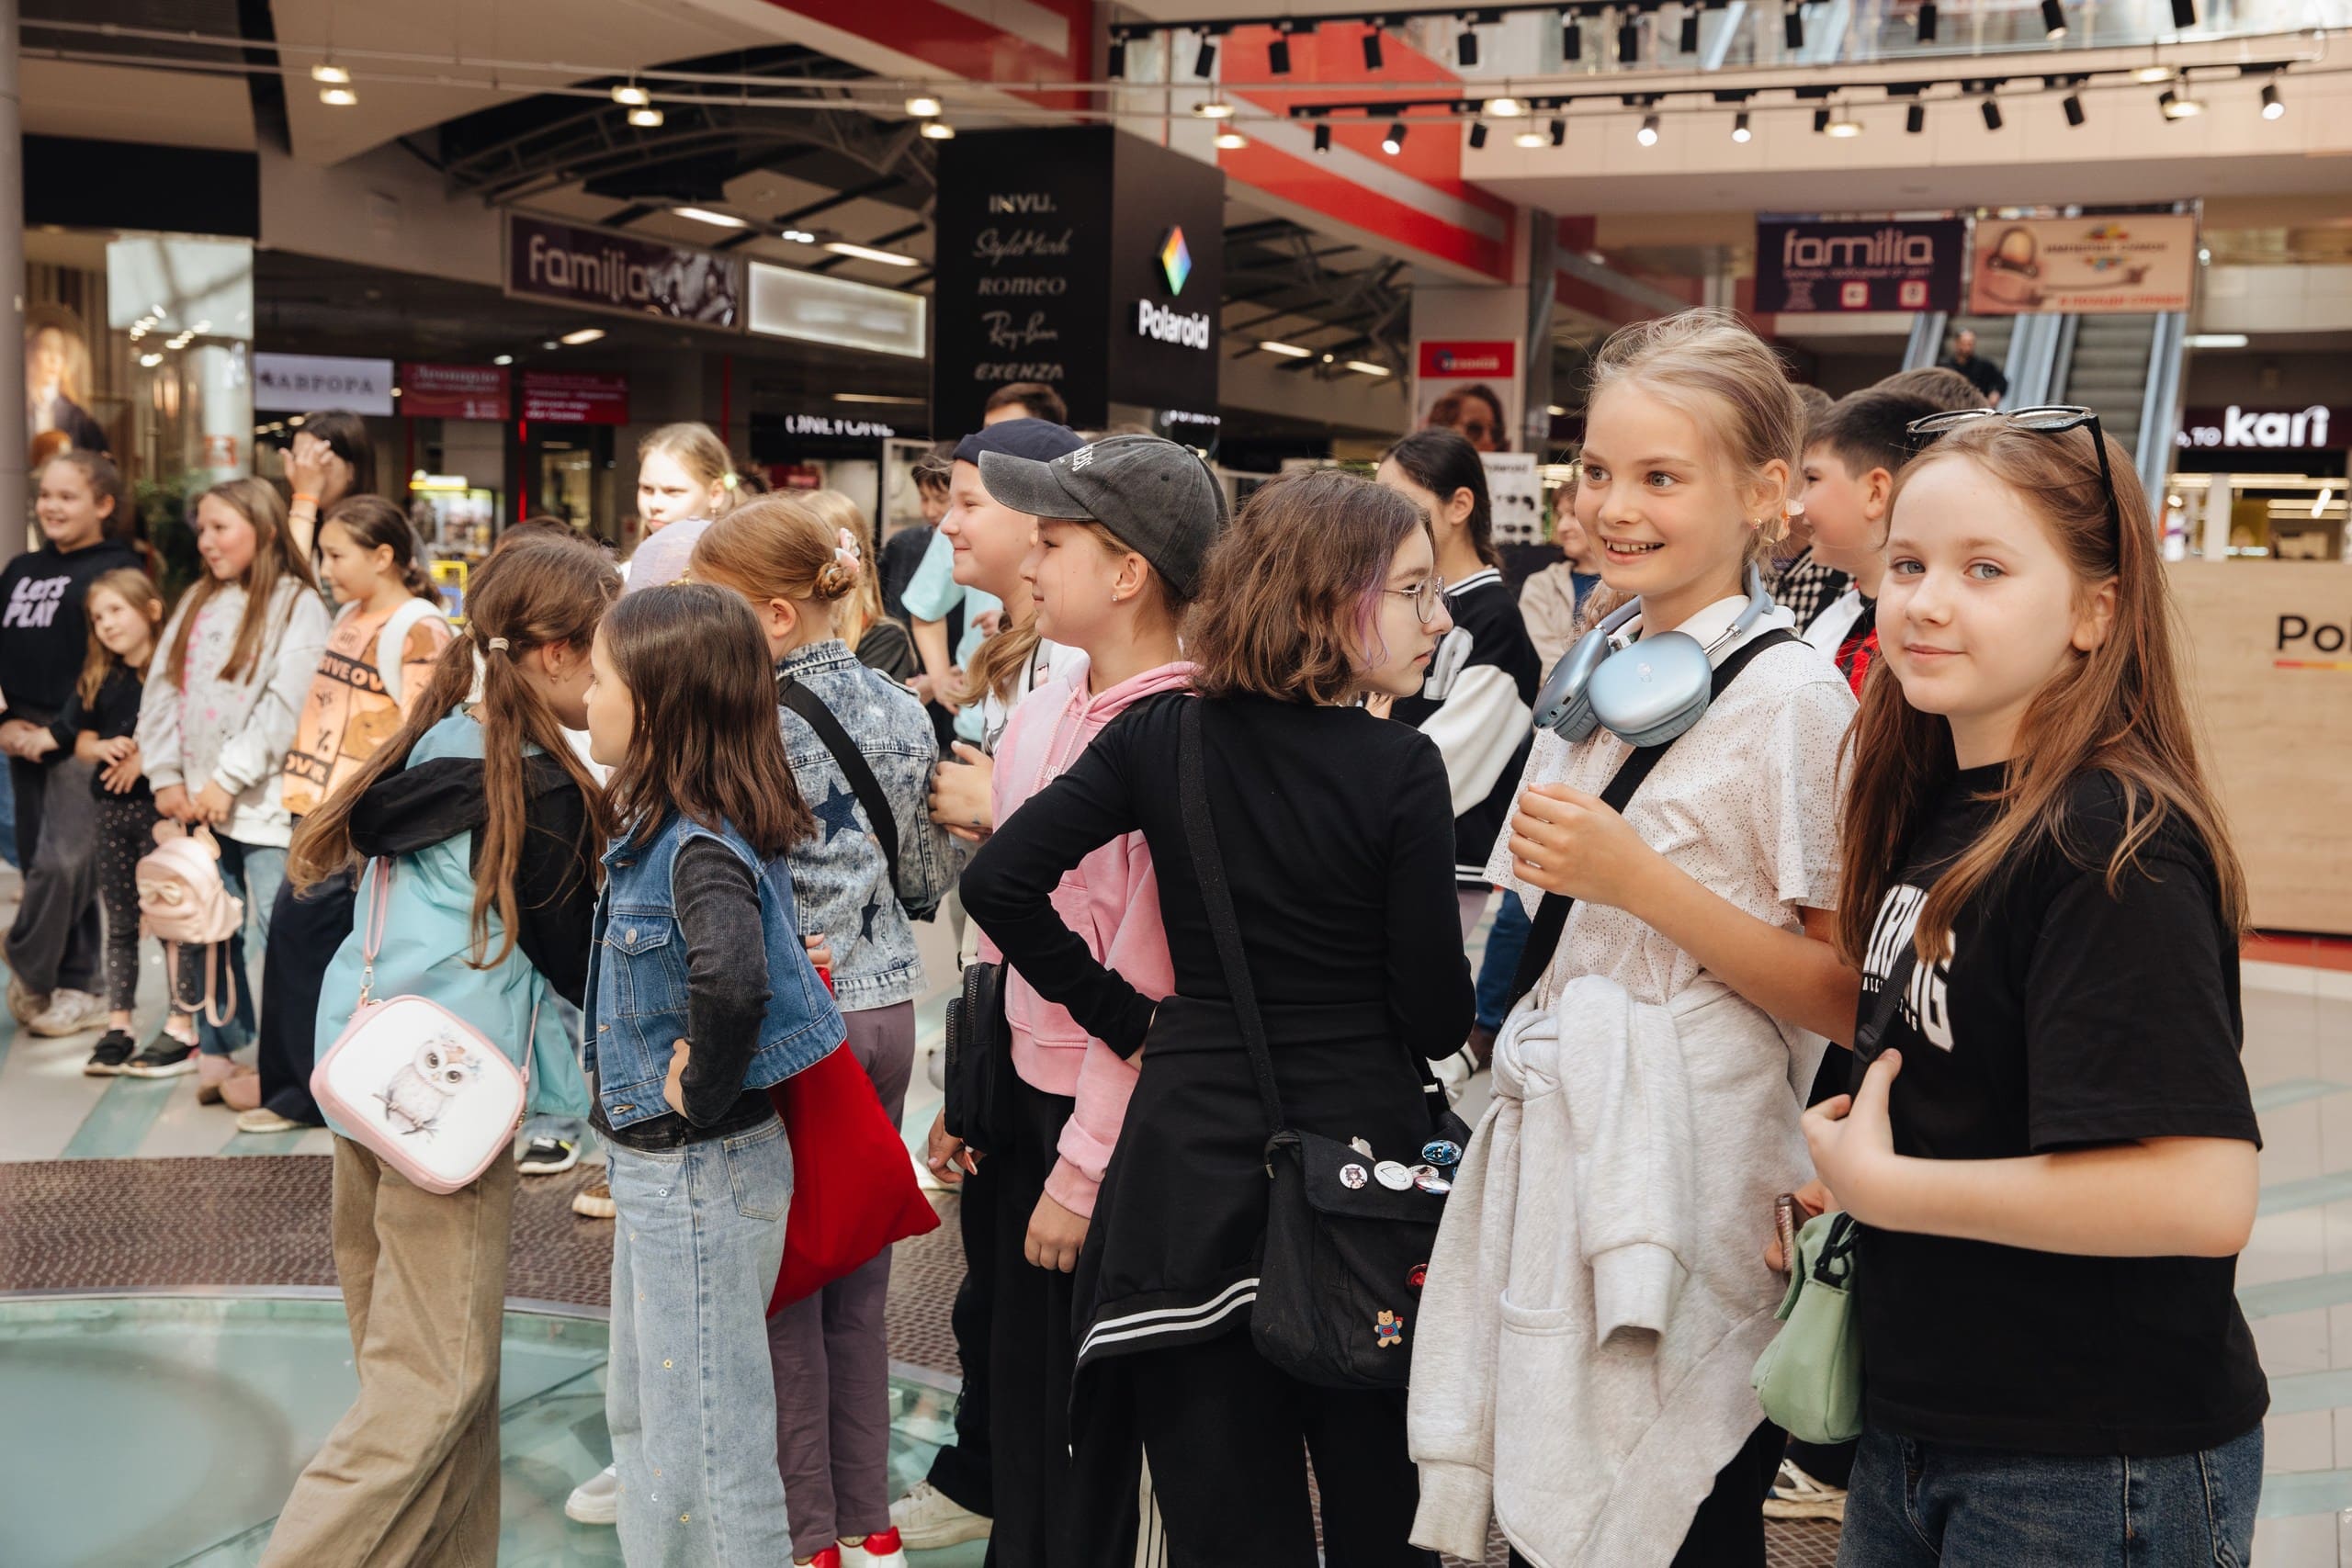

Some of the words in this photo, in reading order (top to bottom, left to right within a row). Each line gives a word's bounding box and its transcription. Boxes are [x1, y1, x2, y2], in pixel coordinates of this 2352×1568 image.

[1782, 228, 1934, 268] familia
[1138, 299, 1209, 349] Polaroid
[2223, 405, 2331, 447] kari
[3, 600, 61, 628] PLAY
